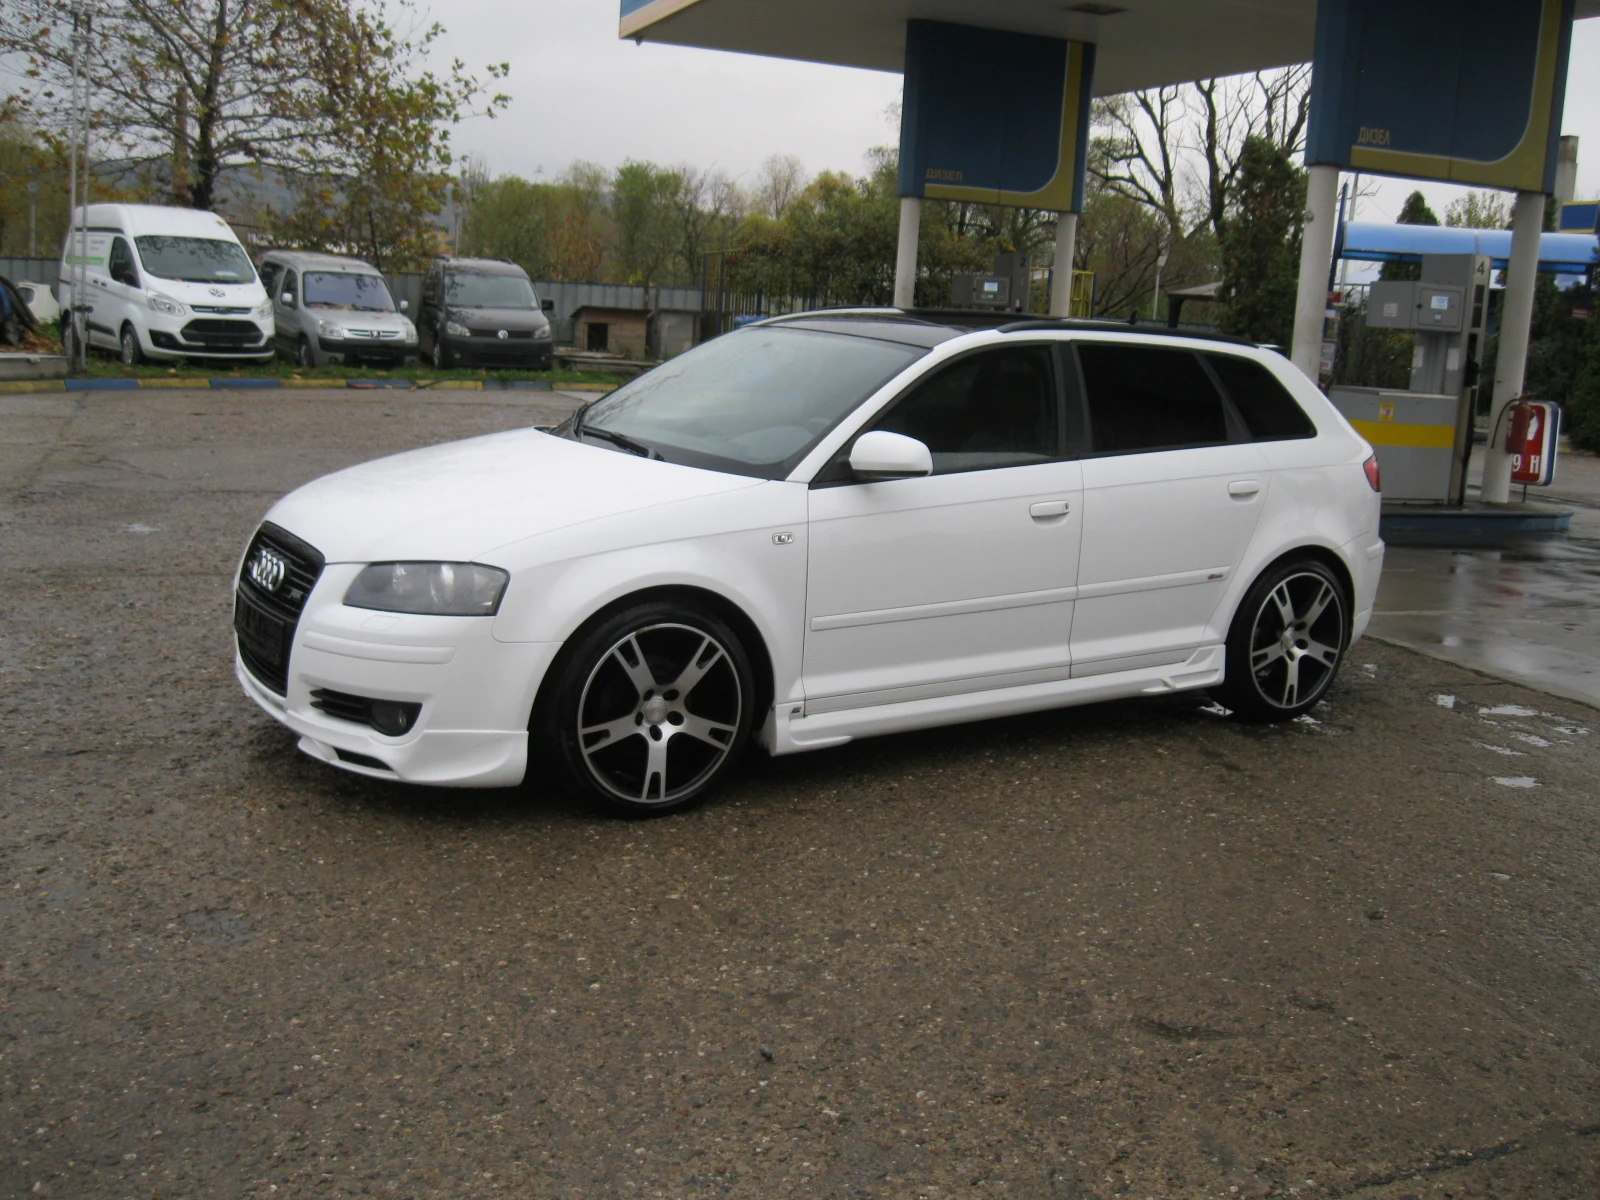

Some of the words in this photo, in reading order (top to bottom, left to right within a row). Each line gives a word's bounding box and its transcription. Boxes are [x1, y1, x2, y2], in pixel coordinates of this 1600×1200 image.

[1357, 126, 1390, 146] ДИЗЕЛ
[925, 168, 963, 181] ДИЗЕЛ
[1521, 156, 1538, 185] 2
[1477, 260, 1485, 276] 4
